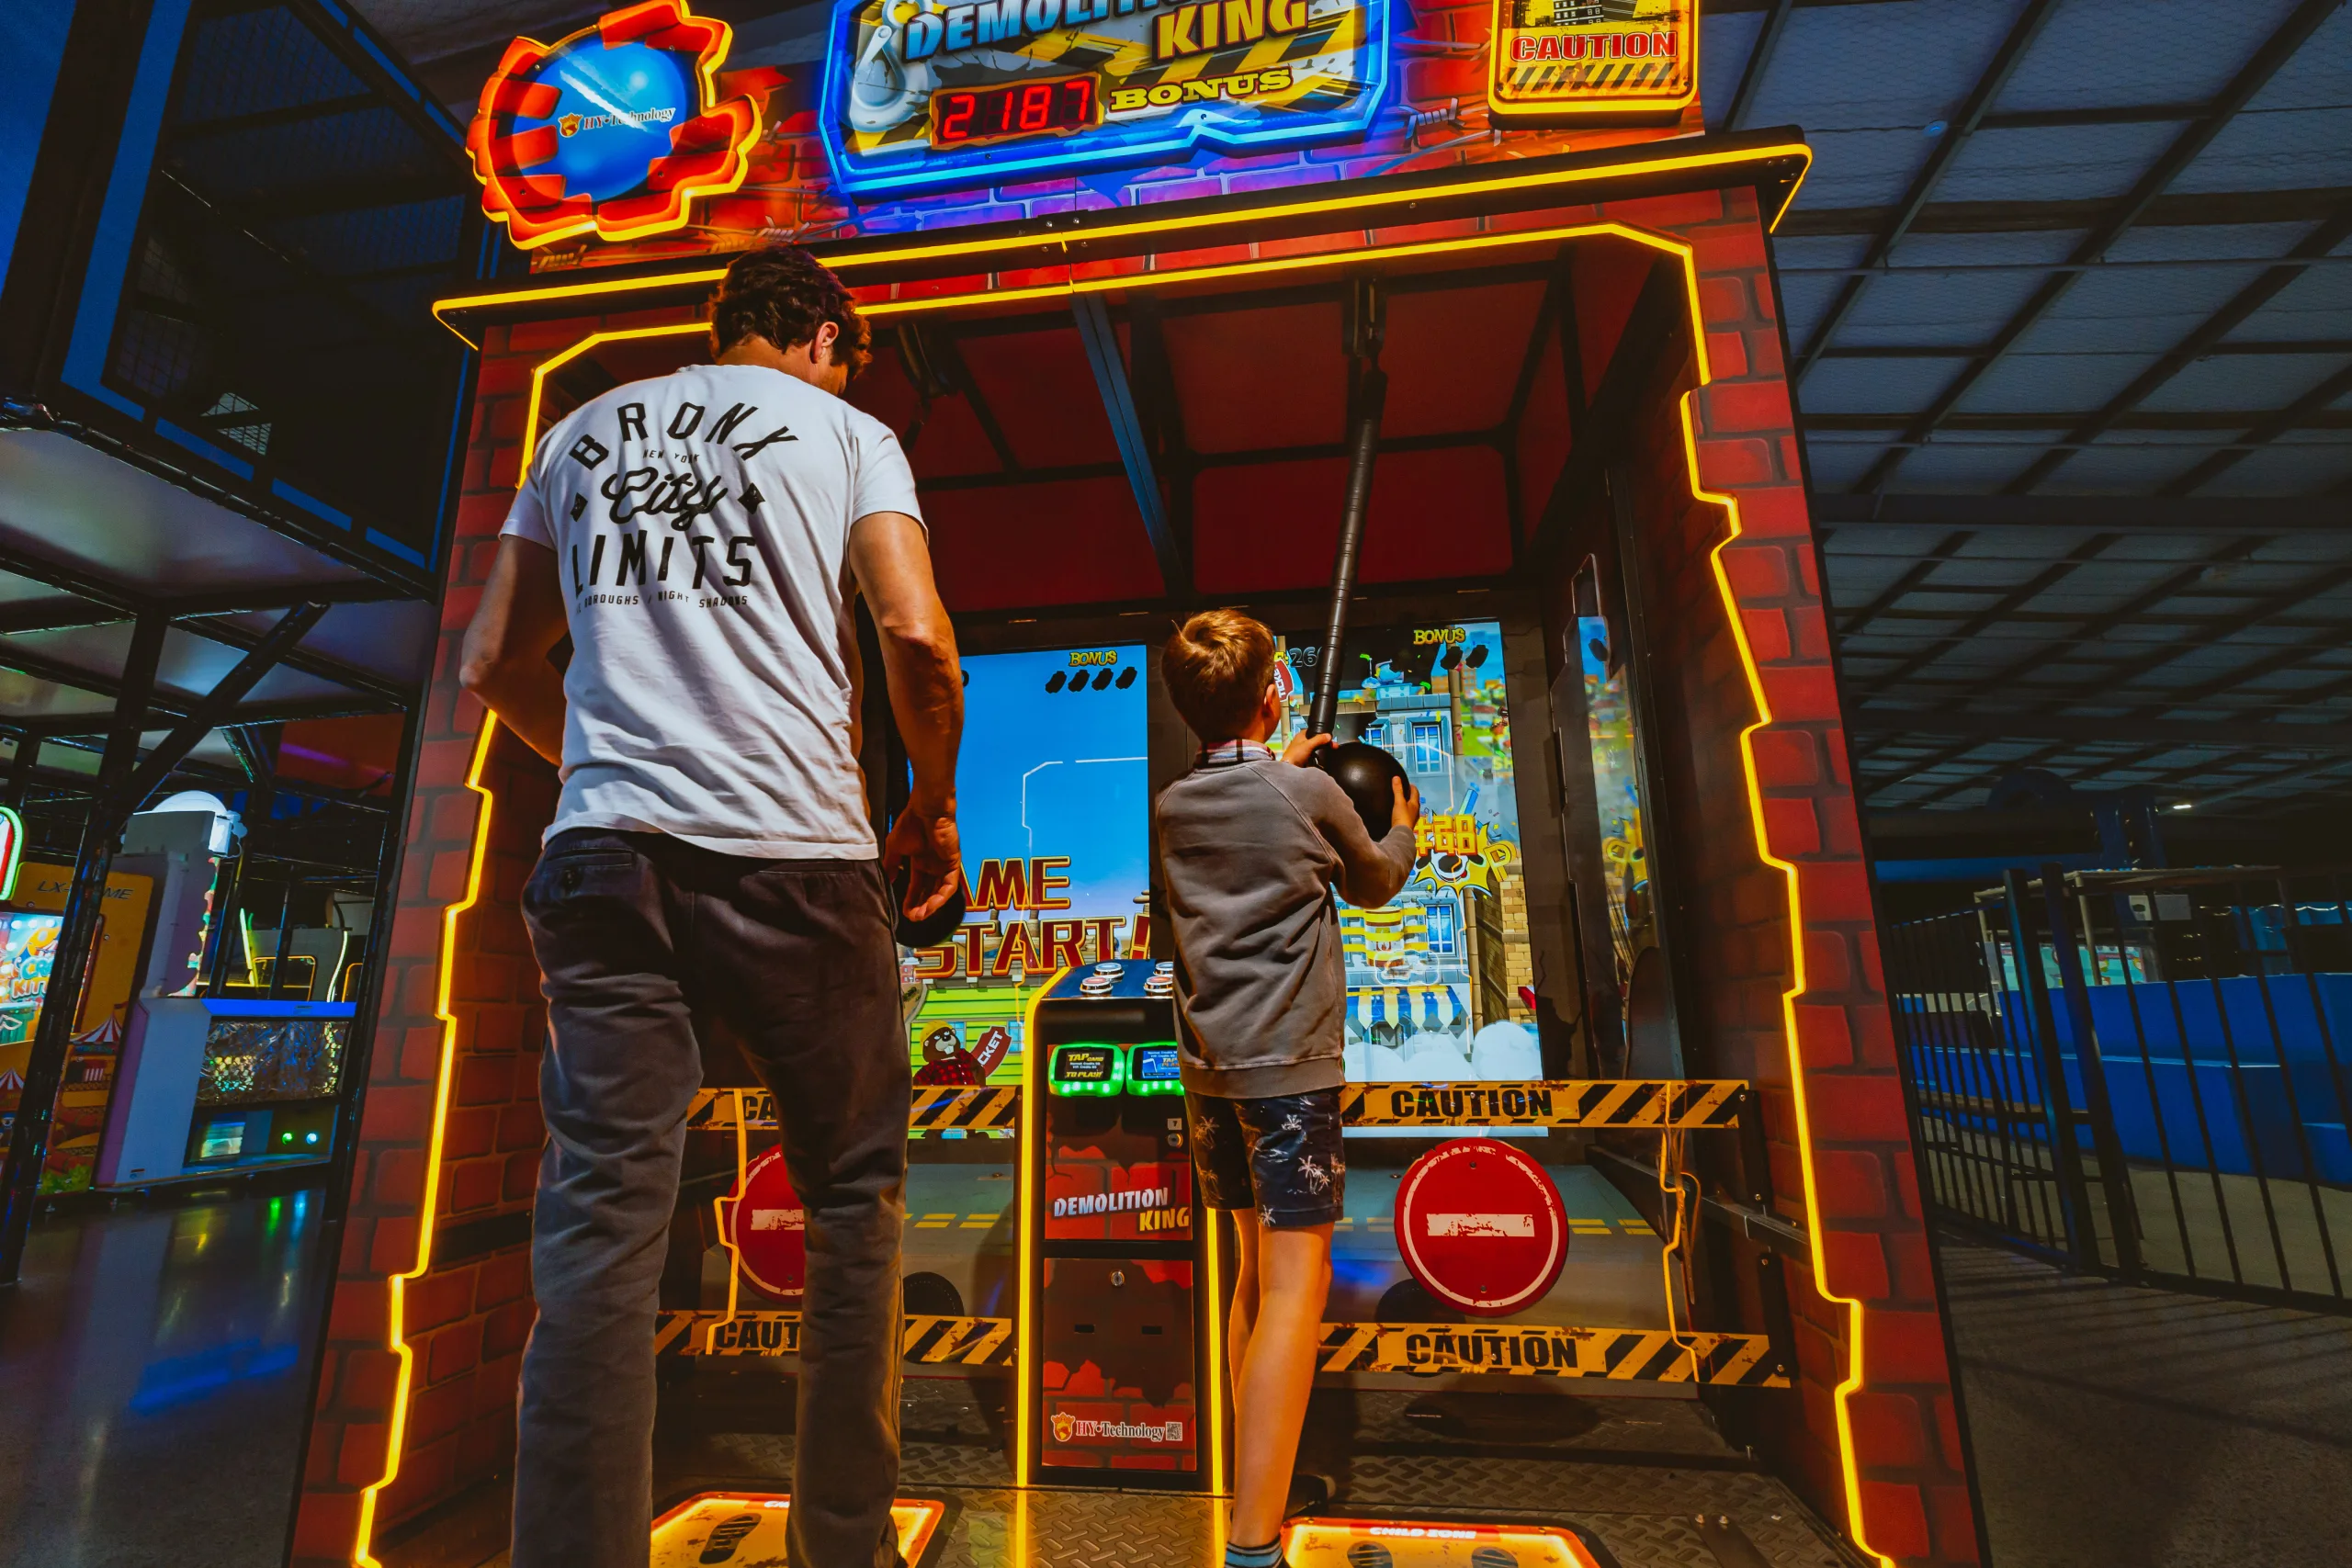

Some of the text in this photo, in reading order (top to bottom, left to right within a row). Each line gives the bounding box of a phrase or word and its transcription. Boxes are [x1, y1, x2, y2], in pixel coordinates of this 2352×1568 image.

[1157, 0, 1309, 60] KING
[1510, 31, 1678, 62] CAUTION
[1109, 67, 1294, 111] BONUS
[943, 80, 1091, 139] 2187
[568, 401, 799, 470] BRONX
[643, 449, 663, 458] NEW
[600, 466, 729, 531] City
[571, 529, 756, 600] LIMITS
[657, 591, 690, 604] NIGHT
[1415, 628, 1465, 645] BONUS
[1069, 650, 1118, 667] BONUS
[1289, 646, 1323, 668] 26
[1391, 1089, 1554, 1118] CAUTION
[1054, 1187, 1169, 1217] DEMOLITION
[1139, 1206, 1190, 1232] KING
[1406, 1334, 1578, 1368] CAUTION
